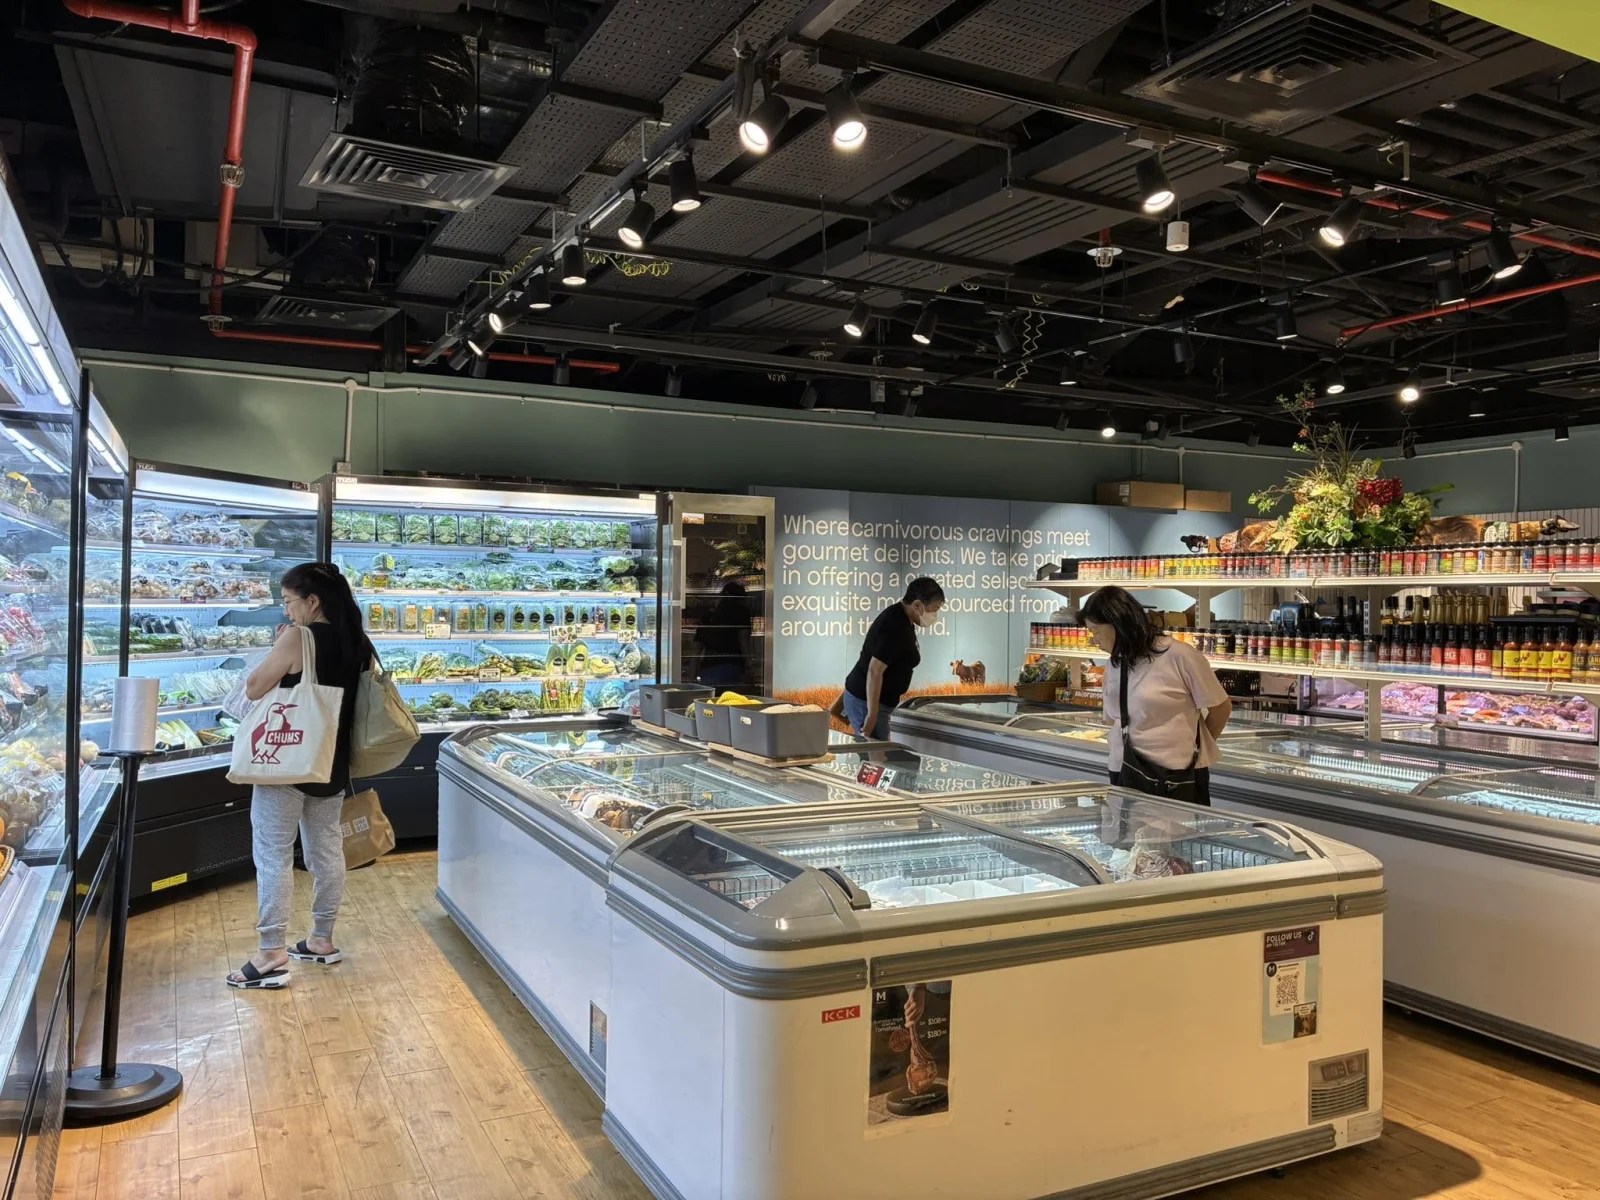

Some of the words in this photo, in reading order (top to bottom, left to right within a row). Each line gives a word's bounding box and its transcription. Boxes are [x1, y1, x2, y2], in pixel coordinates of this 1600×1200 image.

[783, 514, 849, 536] Where
[851, 519, 963, 540] carnivorous
[968, 524, 1042, 548] cravings
[1047, 529, 1091, 546] meet
[782, 543, 869, 565] gourmet
[874, 544, 954, 568] delights.
[960, 547, 986, 565] We
[991, 549, 1029, 566] take
[1033, 549, 1076, 571] prid
[782, 565, 801, 585] in
[807, 566, 884, 592] offering
[889, 572, 900, 587] a
[781, 591, 871, 616] exquisite
[940, 594, 1015, 613] sourced
[1020, 595, 1060, 613] from
[781, 616, 852, 636] around
[267, 731, 301, 744] CHUMS
[1266, 932, 1293, 943] FOLLOW
[1293, 931, 1302, 939] US
[876, 991, 886, 1001] M
[825, 1008, 855, 1021] KCK
